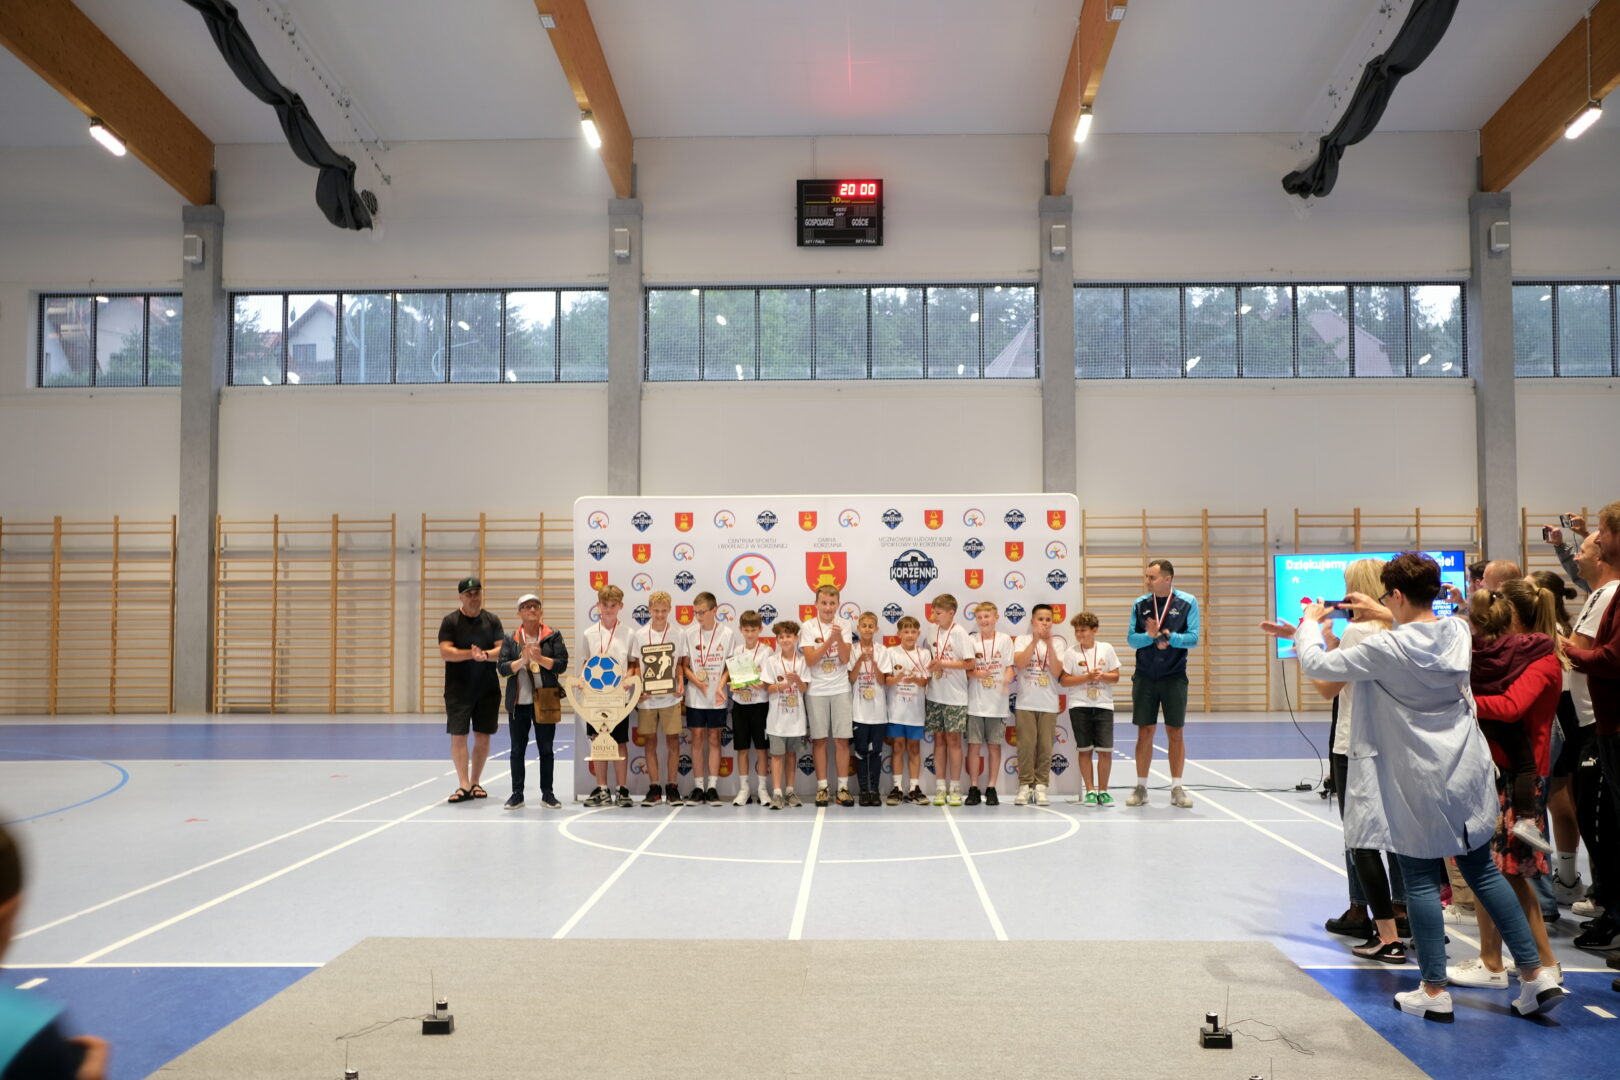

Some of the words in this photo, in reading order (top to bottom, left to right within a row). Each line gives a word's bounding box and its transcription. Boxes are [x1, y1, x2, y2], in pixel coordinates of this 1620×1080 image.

[840, 183, 856, 196] 20
[860, 183, 876, 196] 00
[804, 218, 834, 227] GOSPODARZE
[851, 216, 869, 227] GOŚCIE
[1286, 559, 1347, 572] Dziękujemy
[890, 566, 938, 580] KORZENNA
